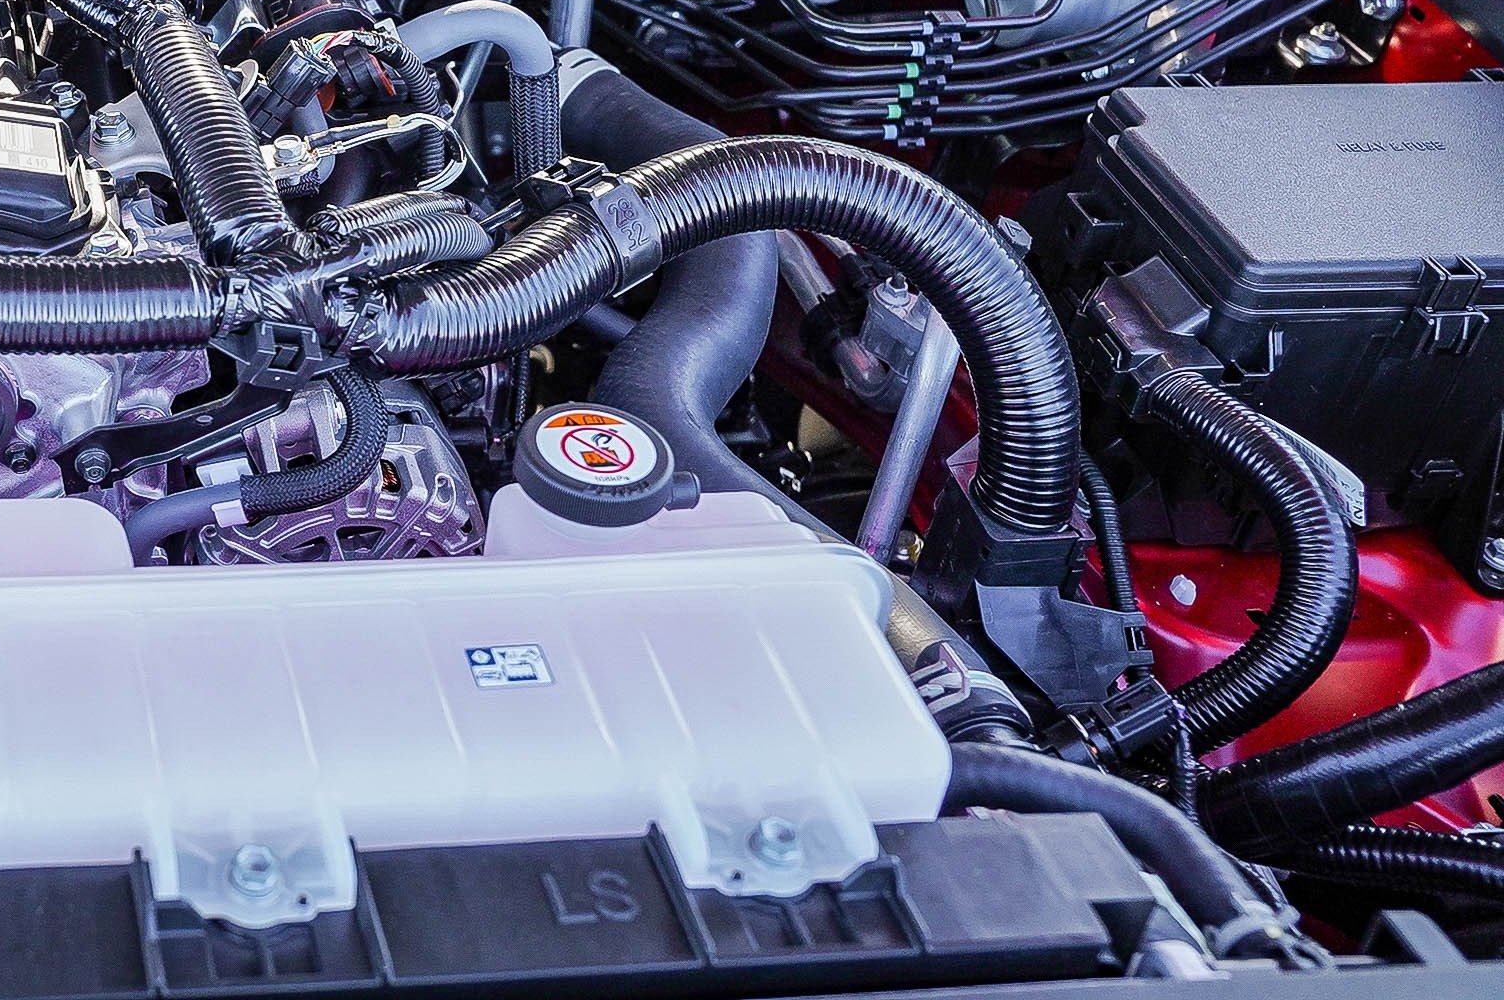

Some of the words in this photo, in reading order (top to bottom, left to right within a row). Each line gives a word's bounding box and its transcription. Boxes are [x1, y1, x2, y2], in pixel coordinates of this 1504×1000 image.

[1335, 141, 1387, 153] RELAY
[1403, 140, 1446, 152] FUSE
[620, 220, 649, 251] 32
[540, 869, 642, 928] LS
